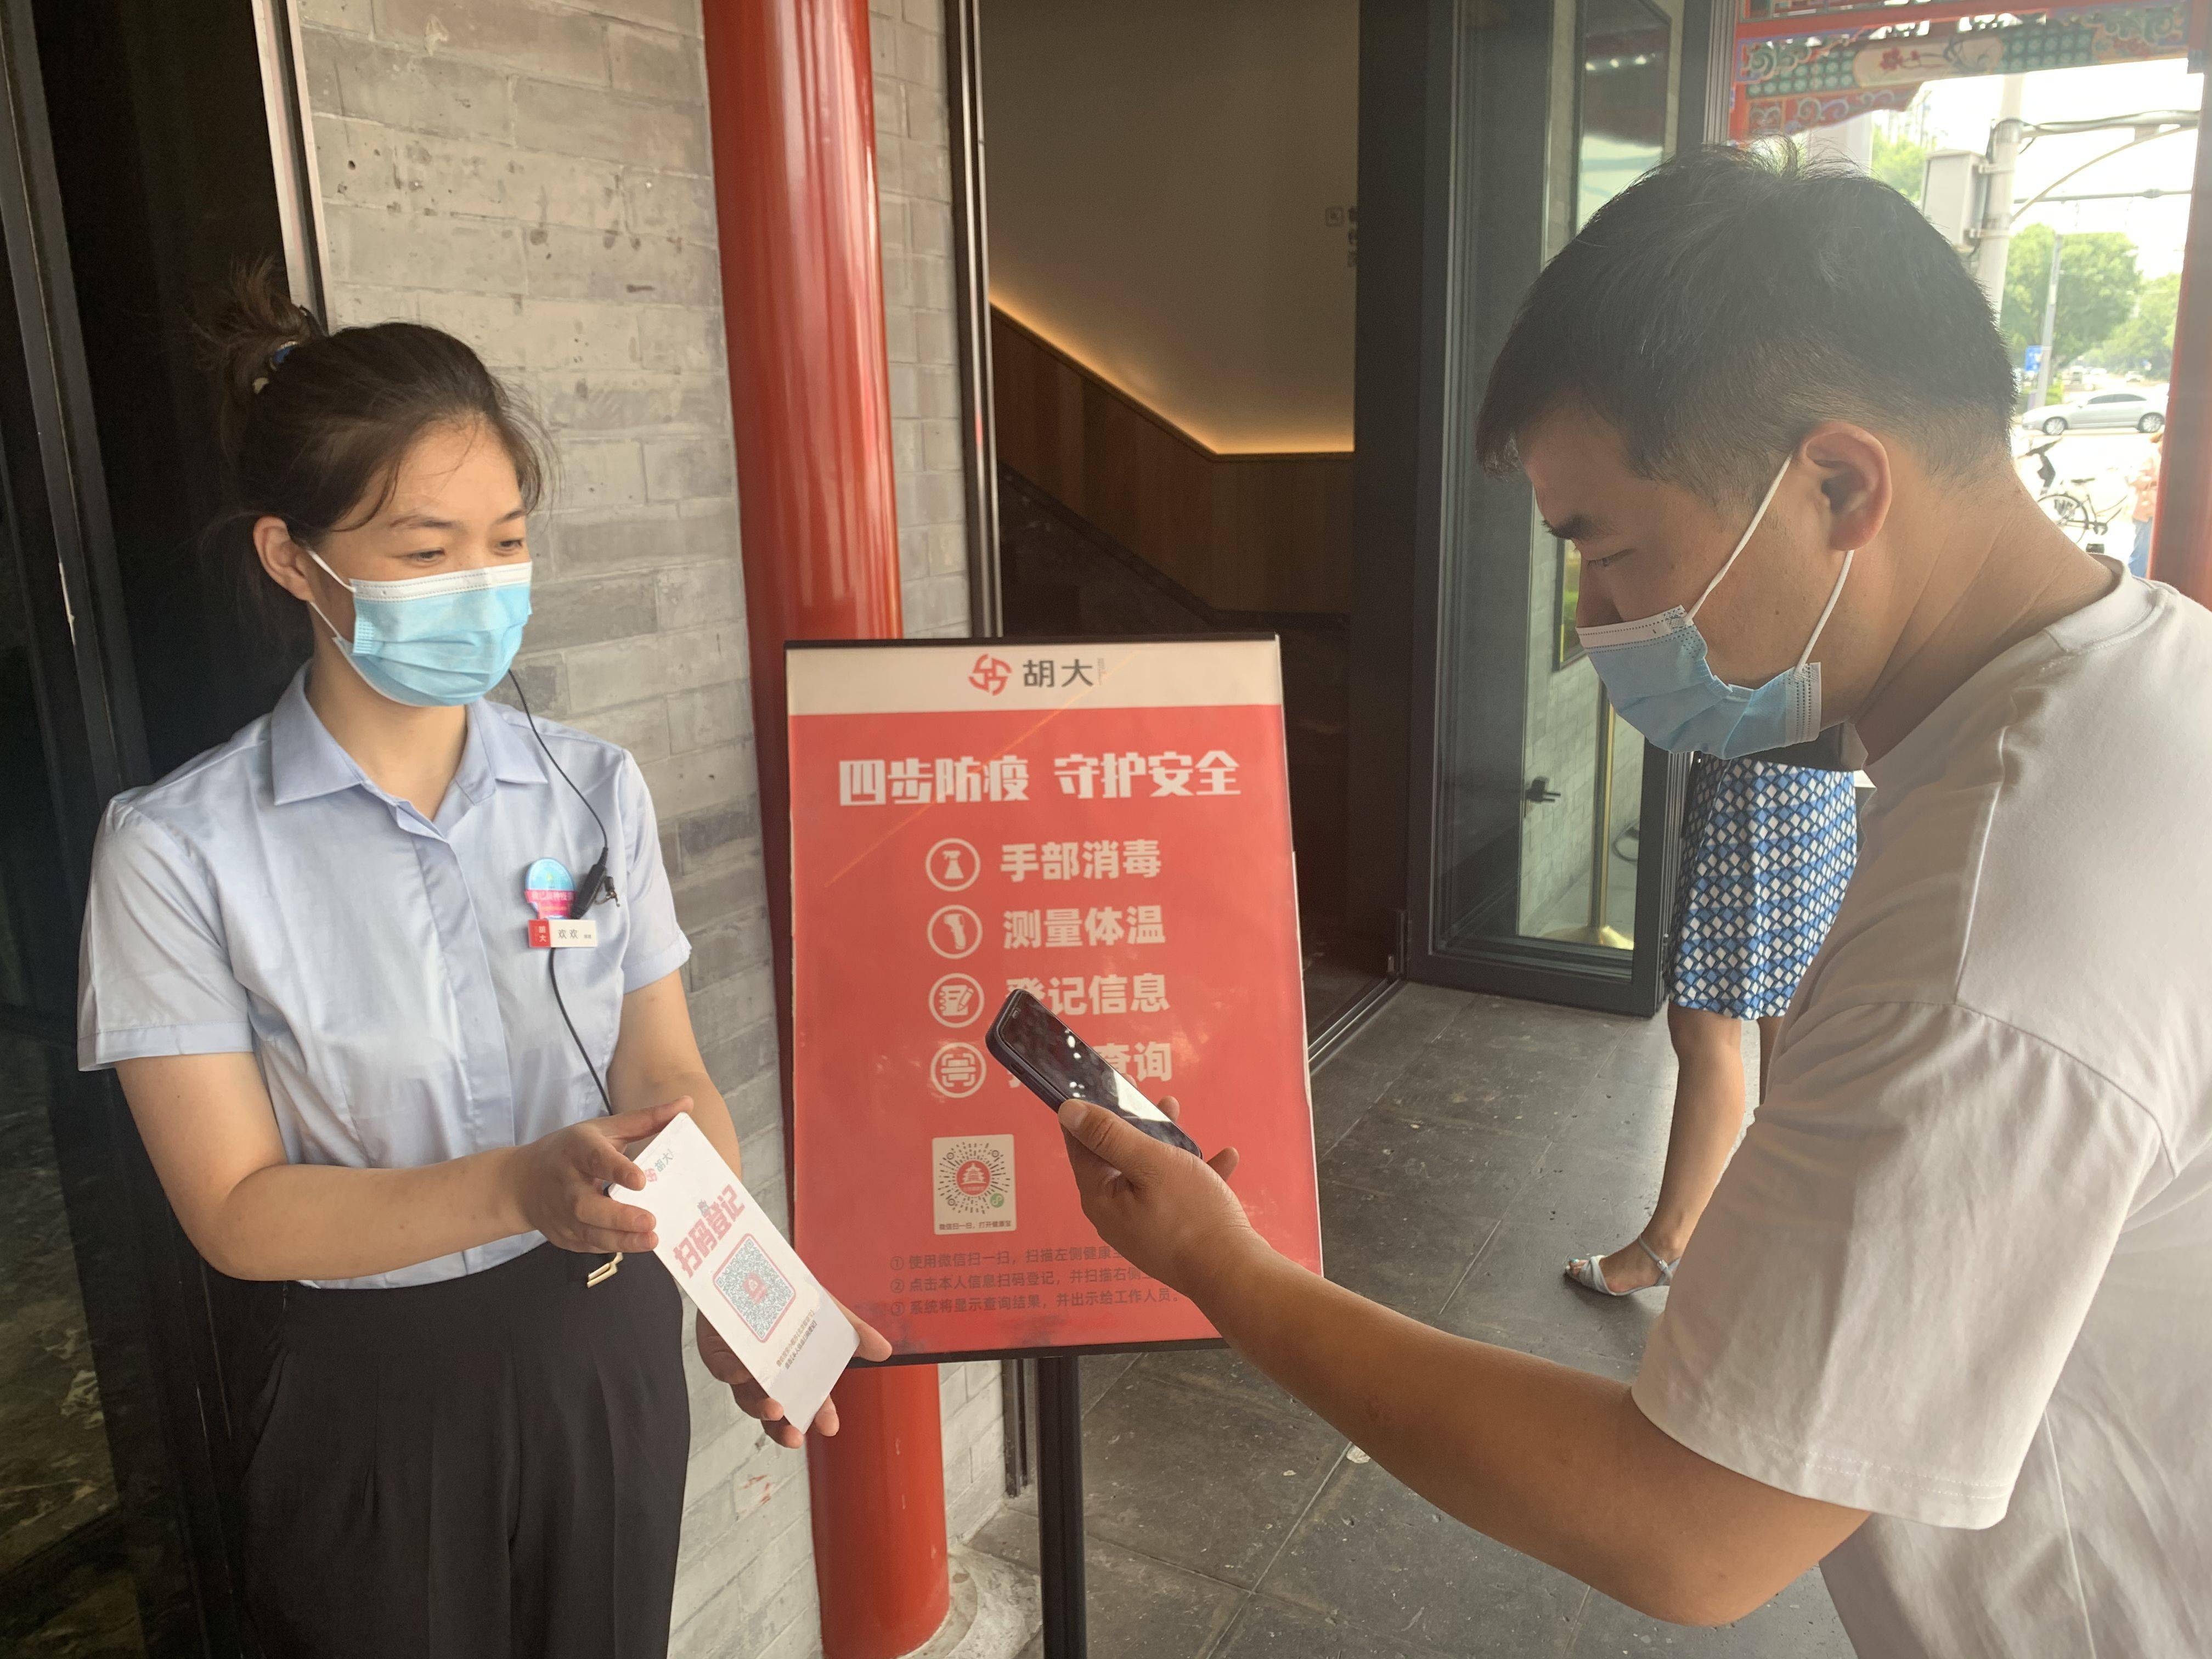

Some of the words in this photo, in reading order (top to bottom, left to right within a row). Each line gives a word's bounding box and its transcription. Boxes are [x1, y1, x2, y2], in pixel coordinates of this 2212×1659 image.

[1022, 658, 1094, 687] 胡大
[839, 755, 1030, 806] 四步防疫
[1054, 749, 1242, 799] 守护安全
[1000, 839, 1161, 882] 手部消毒
[1002, 905, 1166, 949] 测量体温
[673, 1184, 746, 1279] 扫码登记
